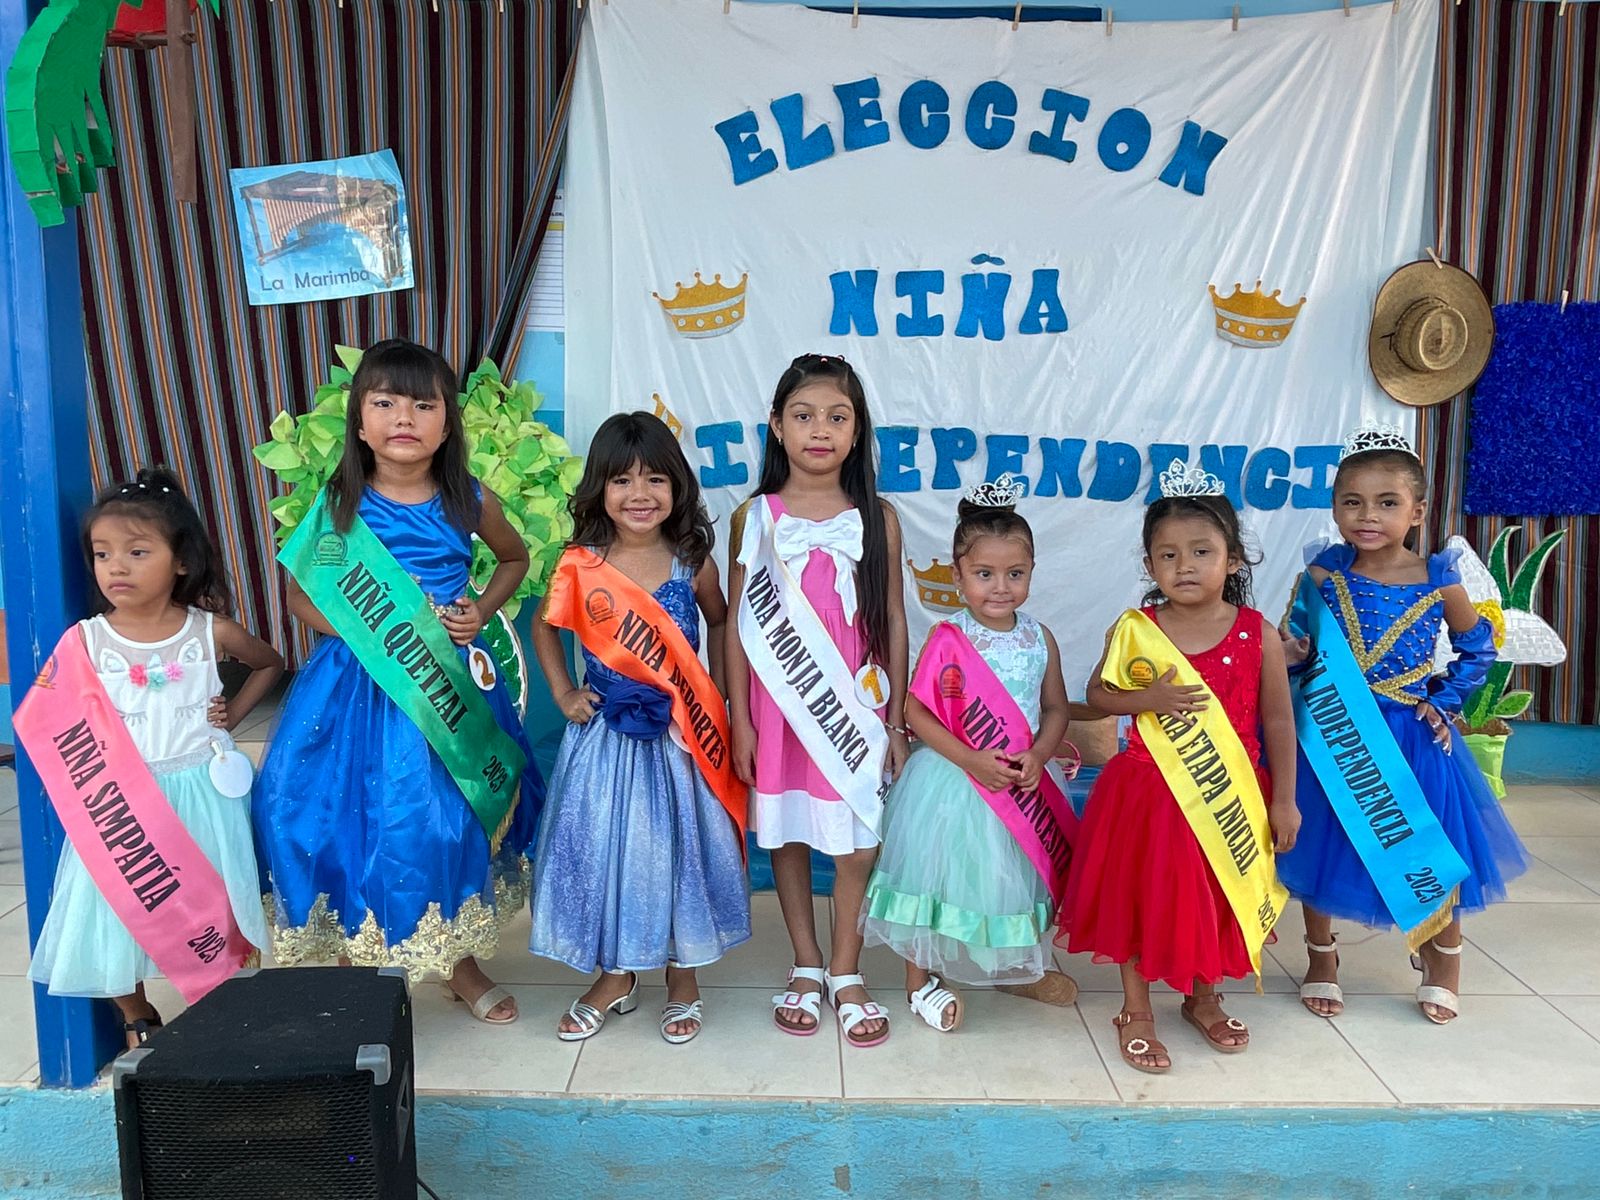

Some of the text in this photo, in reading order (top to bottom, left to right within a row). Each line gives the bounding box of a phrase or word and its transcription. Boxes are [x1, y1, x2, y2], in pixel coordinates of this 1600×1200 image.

[714, 77, 1228, 196] ELECCION
[260, 267, 371, 291] La Marimba
[829, 253, 1068, 341] NIÑA
[336, 561, 469, 734] NIÑA QUETZAL
[473, 651, 495, 687] 2
[613, 608, 668, 672] NIÑA
[746, 565, 870, 774] NIÑA MONJA BLANCA
[860, 667, 884, 704] 1
[52, 718, 108, 791] NIÑA
[482, 755, 508, 793] 2023
[1303, 682, 1416, 851] INDEPENDENCIA
[1176, 728, 1233, 805] ETAPA
[1212, 795, 1260, 878] INICIAL
[1257, 893, 1276, 934] 2023
[1404, 866, 1446, 904] 2023
[186, 925, 226, 964] 2023
